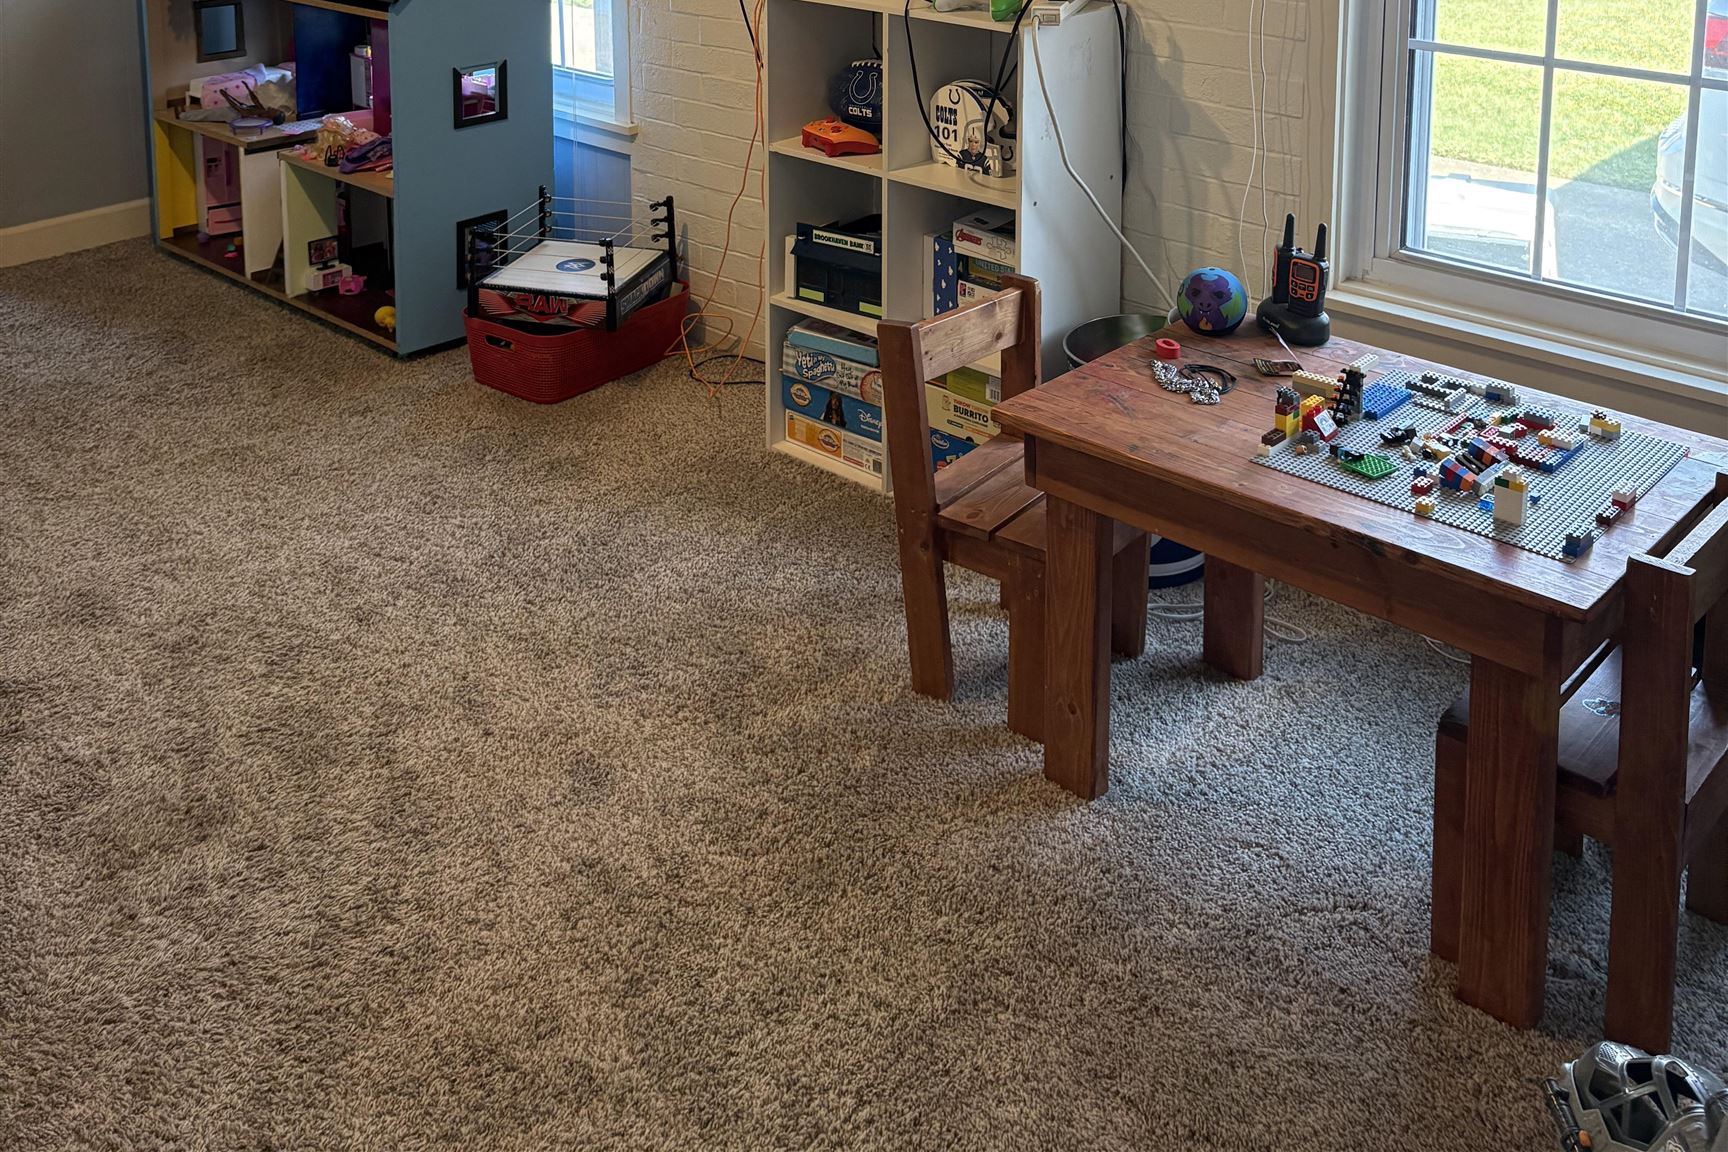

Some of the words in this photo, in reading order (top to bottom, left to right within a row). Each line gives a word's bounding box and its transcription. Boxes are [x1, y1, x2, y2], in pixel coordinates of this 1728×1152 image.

[848, 106, 873, 118] COLTS
[936, 104, 958, 126] COLTS
[934, 125, 958, 142] 101
[796, 350, 814, 368] Yeti
[954, 404, 989, 423] BURRITO
